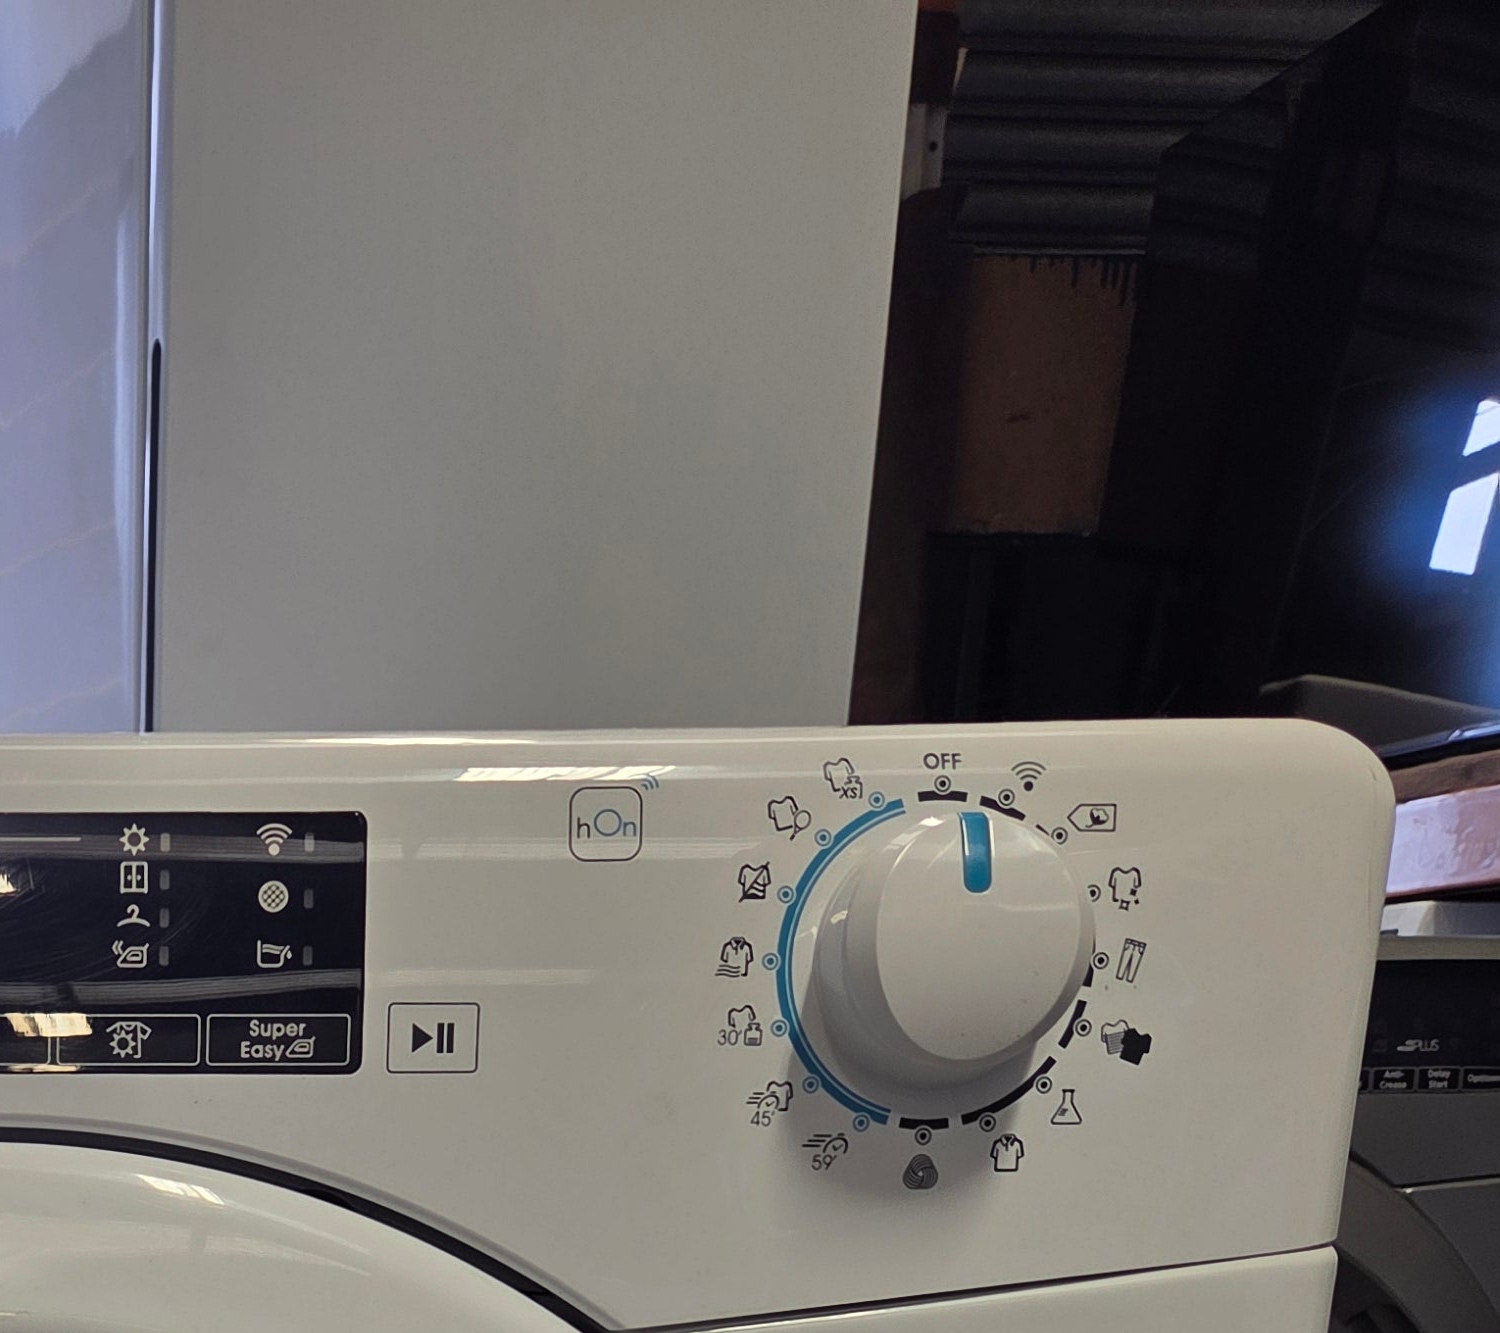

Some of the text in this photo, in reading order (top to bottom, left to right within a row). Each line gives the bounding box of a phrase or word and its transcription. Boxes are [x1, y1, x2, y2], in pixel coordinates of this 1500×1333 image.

[923, 752, 962, 770] OFF
[839, 786, 858, 799] XS
[576, 808, 638, 839] hOn
[249, 1019, 307, 1040] Super
[240, 1041, 285, 1061] Easy
